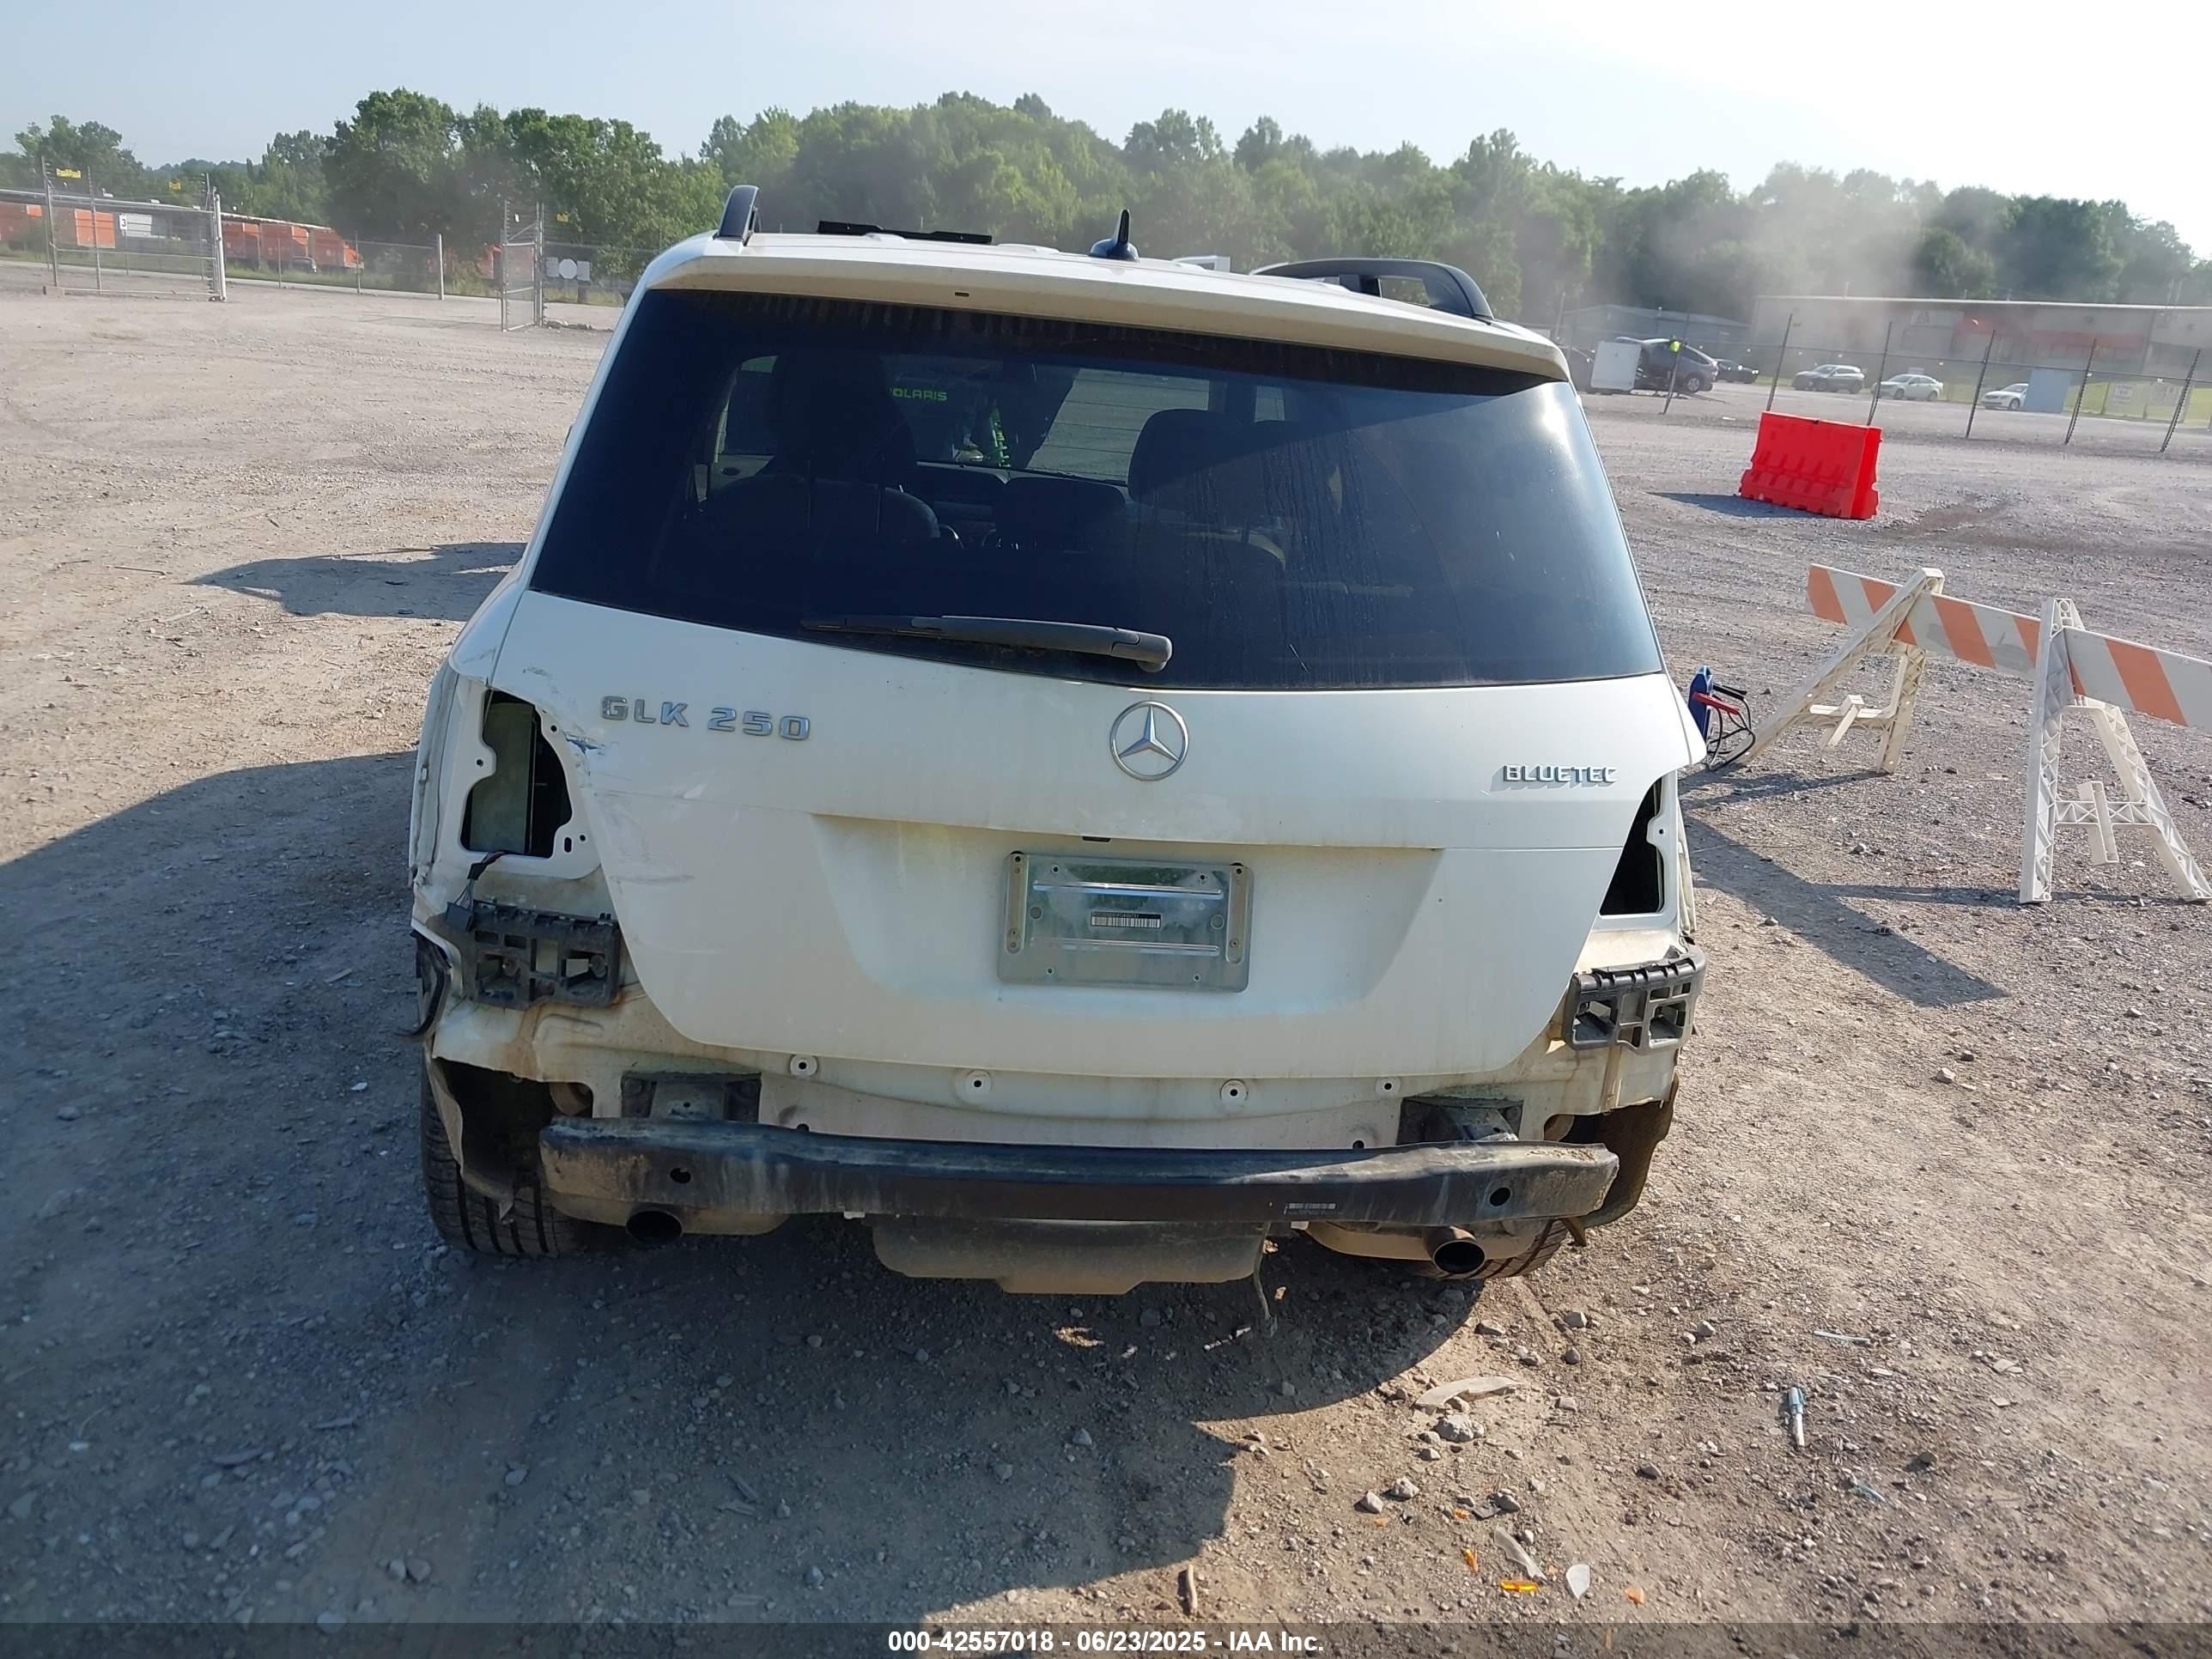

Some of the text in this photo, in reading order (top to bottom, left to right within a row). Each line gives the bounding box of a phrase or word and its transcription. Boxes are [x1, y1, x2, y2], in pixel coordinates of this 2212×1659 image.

[121, 218, 127, 228] 3
[890, 387, 948, 402] OLARIS
[600, 695, 811, 741] GLK 250
[1503, 764, 1617, 784] BLUETEC
